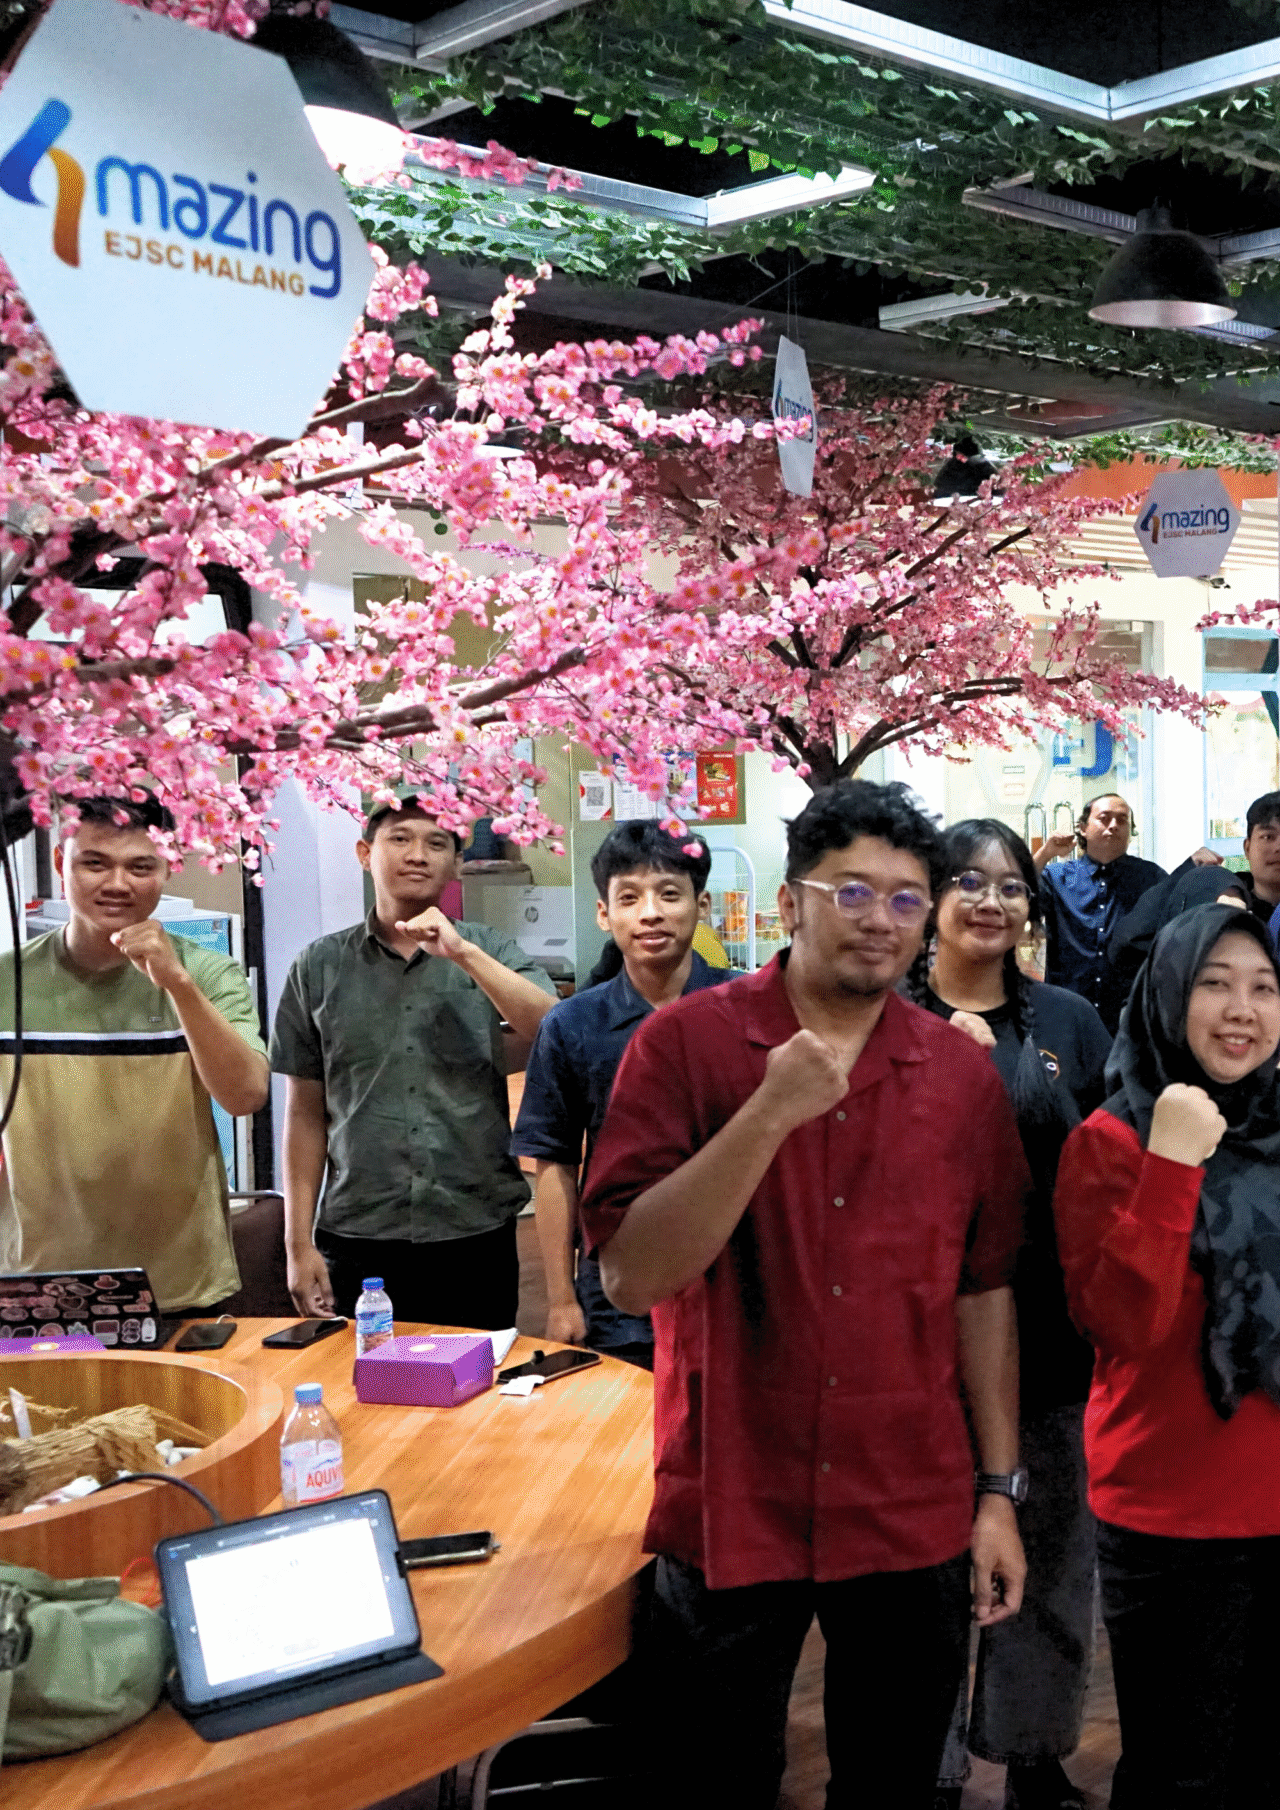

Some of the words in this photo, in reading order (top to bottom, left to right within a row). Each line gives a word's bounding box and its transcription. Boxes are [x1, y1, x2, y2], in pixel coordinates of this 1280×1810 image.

[104, 230, 184, 269] EJSC
[192, 249, 305, 297] MALANG
[1163, 531, 1183, 539] EJSC
[1185, 528, 1218, 537] MALANG
